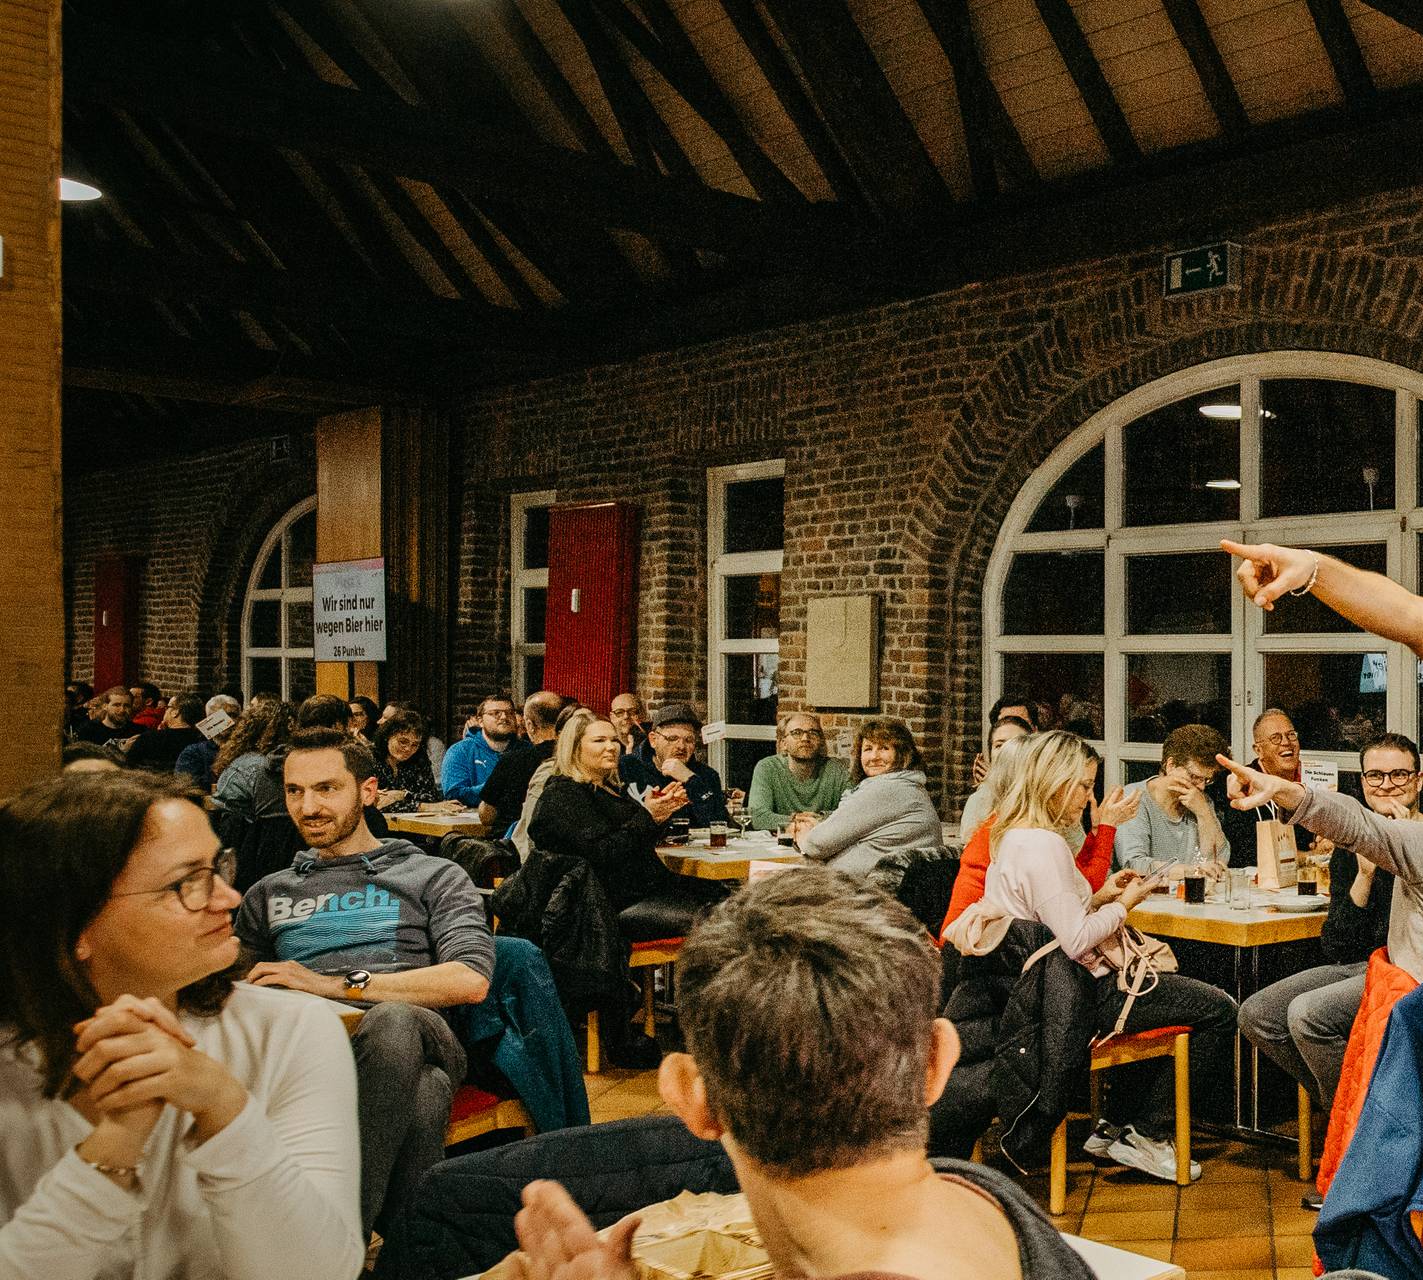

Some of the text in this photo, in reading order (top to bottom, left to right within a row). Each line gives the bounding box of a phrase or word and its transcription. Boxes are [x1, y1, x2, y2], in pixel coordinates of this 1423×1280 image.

[322, 594, 375, 611] Wir sind nur
[316, 615, 383, 637] wegen Bier hier
[342, 645, 365, 657] Punkte
[268, 883, 400, 920] Bench.
